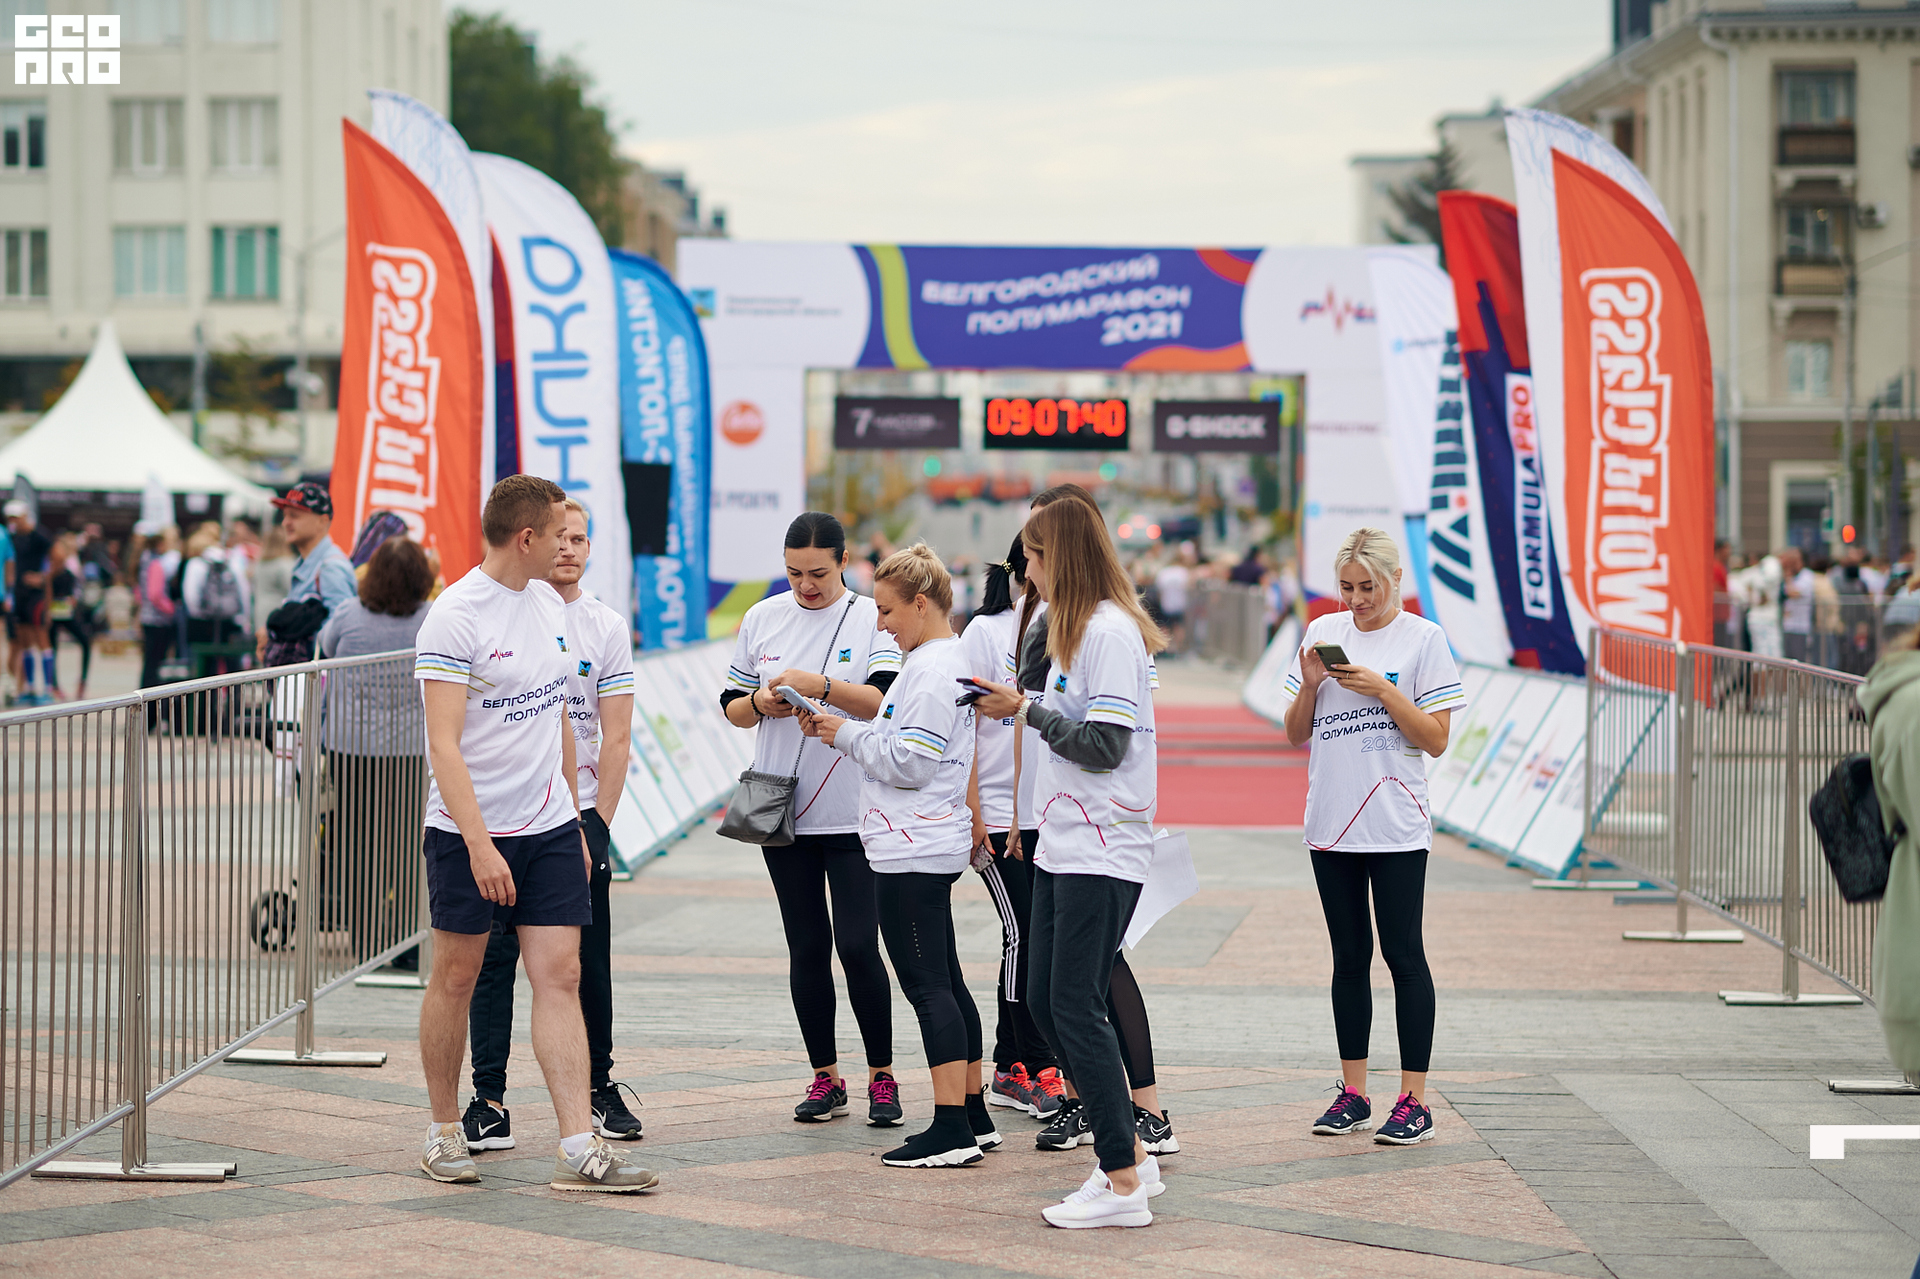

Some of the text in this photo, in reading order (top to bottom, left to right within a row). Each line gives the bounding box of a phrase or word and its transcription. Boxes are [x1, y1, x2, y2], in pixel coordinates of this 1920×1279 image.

[921, 252, 1161, 306] БЕЛГОРОДСКИЙ
[965, 284, 1192, 336] ПОЛУМАРАФОН
[1100, 309, 1183, 346] 2021
[1361, 735, 1401, 753] 2021
